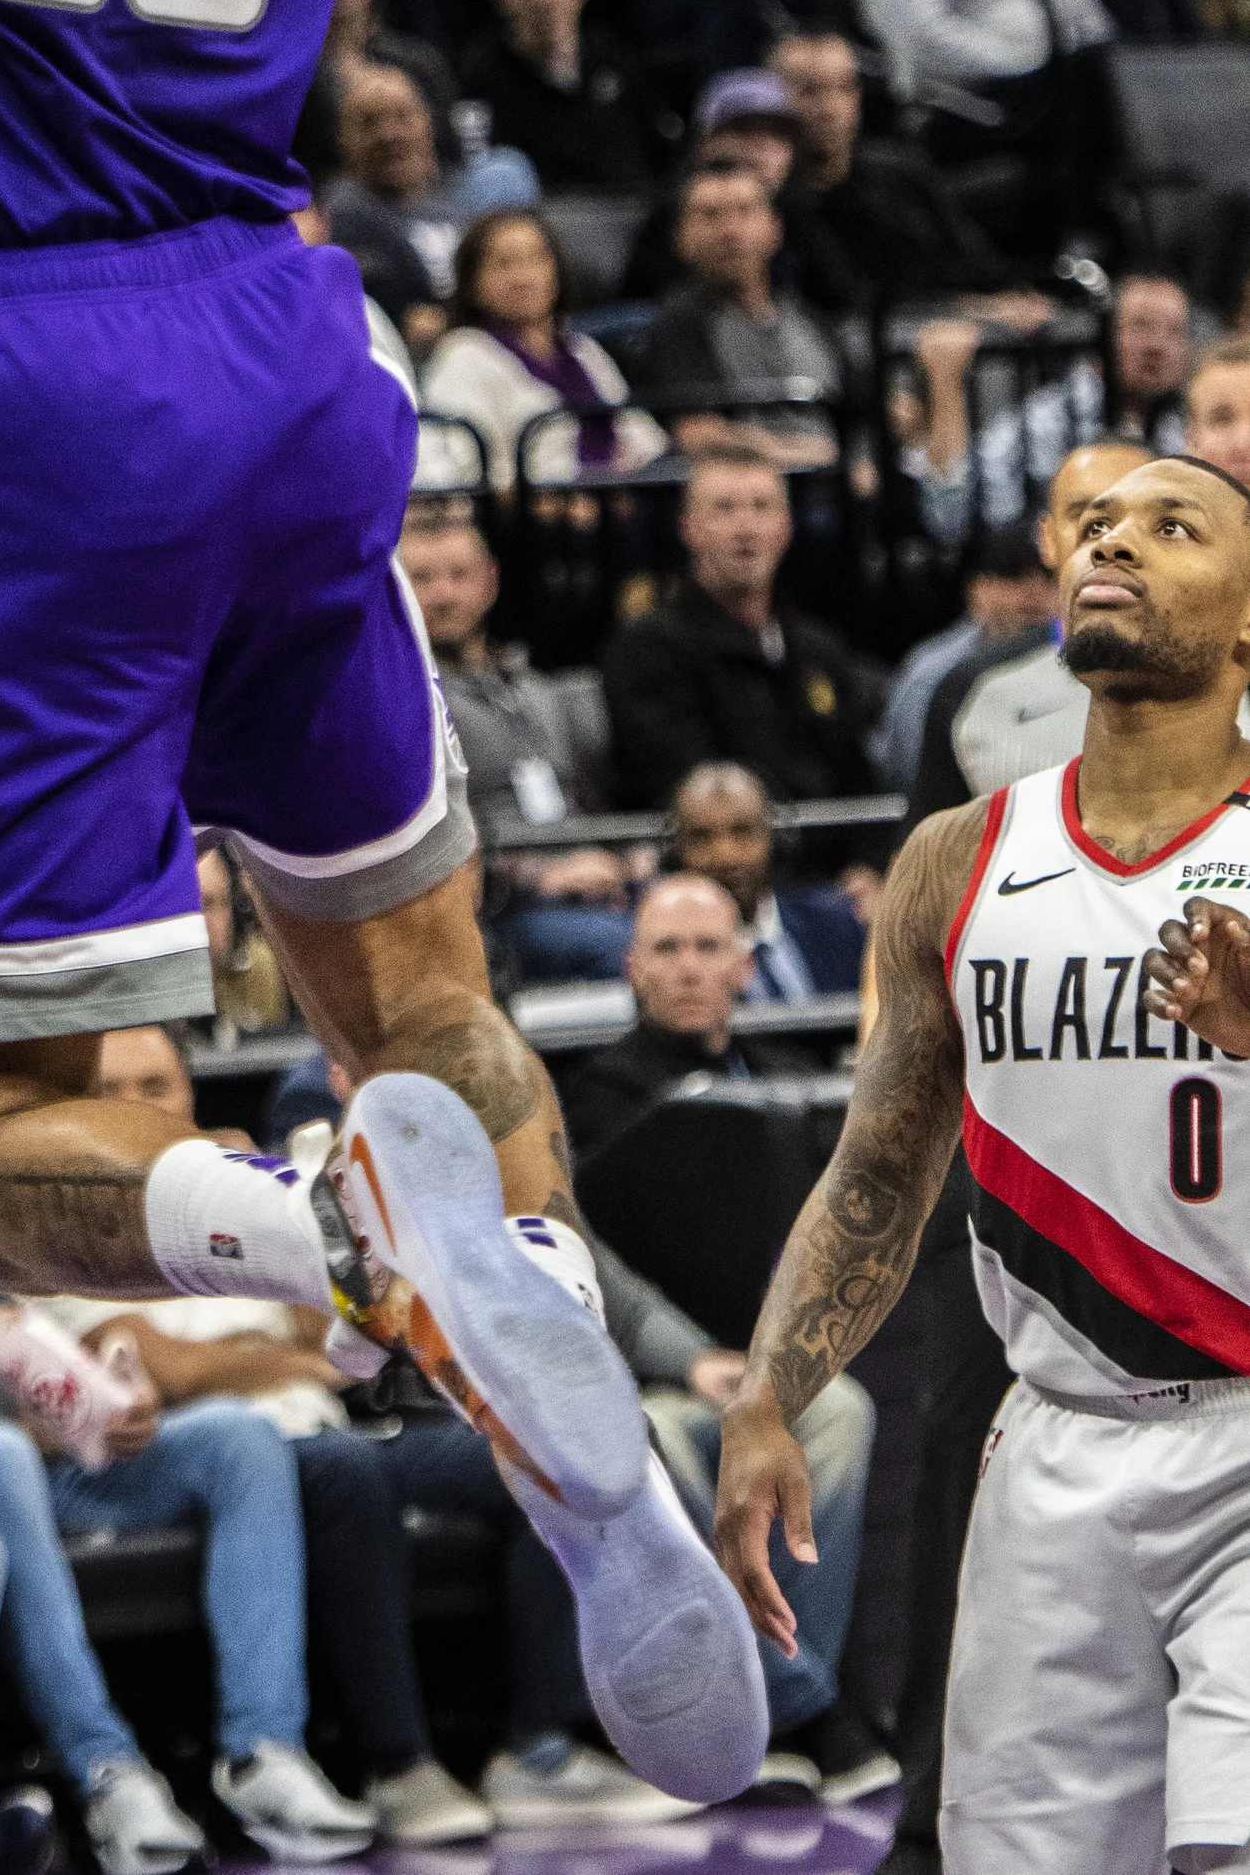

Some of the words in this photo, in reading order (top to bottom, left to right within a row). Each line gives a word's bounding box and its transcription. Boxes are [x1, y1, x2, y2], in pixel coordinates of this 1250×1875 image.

[1182, 862, 1250, 878] BIOFREE
[969, 955, 1250, 1062] BLAZE
[1169, 1078, 1222, 1204] 0
